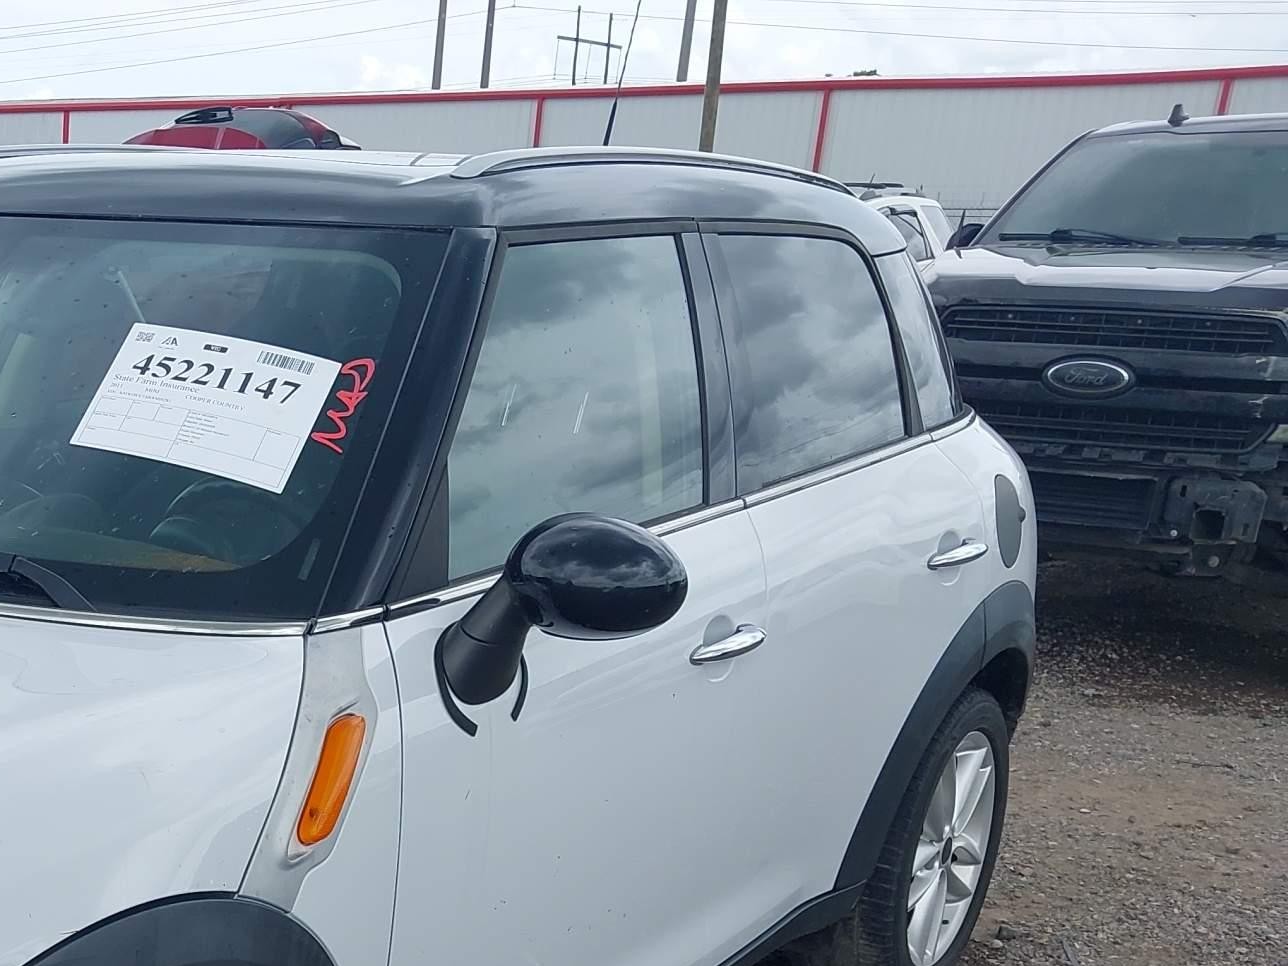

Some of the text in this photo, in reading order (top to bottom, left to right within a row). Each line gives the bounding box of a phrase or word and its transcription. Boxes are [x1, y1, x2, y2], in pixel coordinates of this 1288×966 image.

[113, 373, 200, 394] State Farm Insurance
[132, 354, 302, 404] 45221147
[185, 394, 212, 405] COOPER
